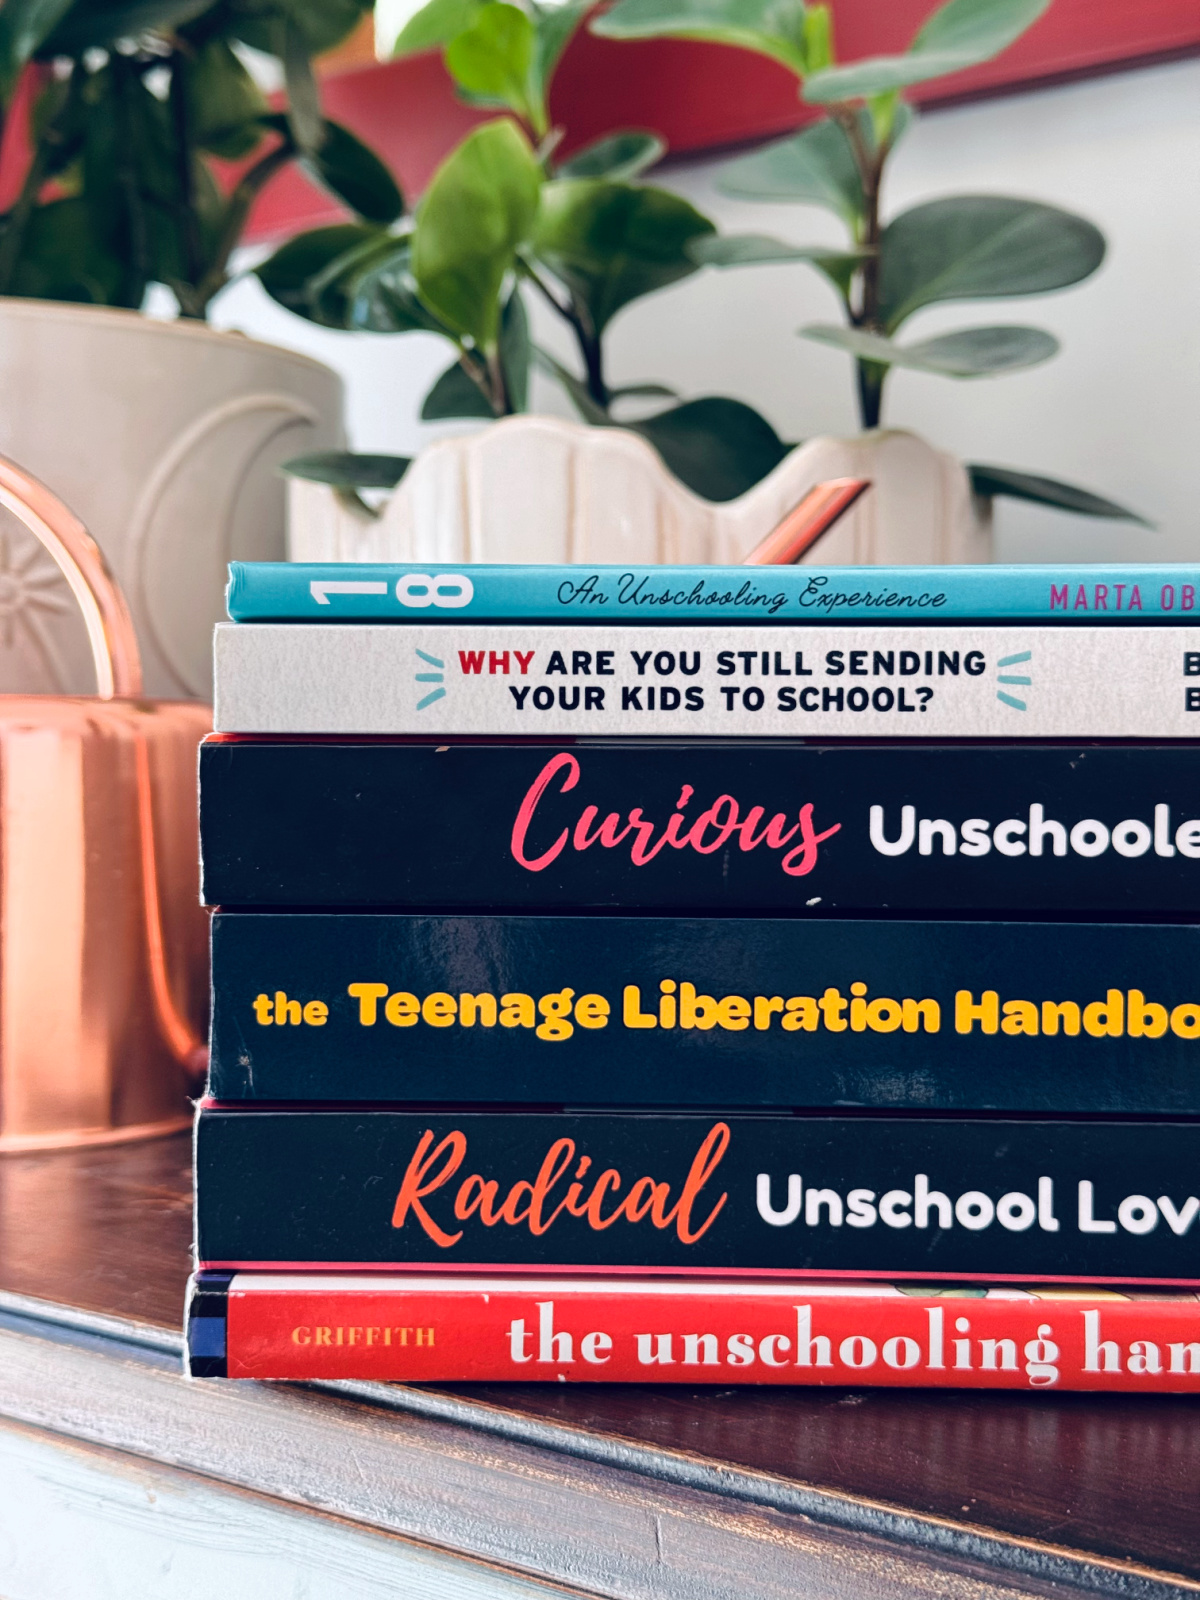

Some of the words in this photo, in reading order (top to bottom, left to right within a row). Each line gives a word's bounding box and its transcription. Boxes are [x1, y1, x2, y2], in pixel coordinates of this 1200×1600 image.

[557, 573, 609, 606] An
[617, 573, 788, 614] Unschooling
[799, 575, 948, 614] Experience
[1049, 583, 1143, 612] MARTA
[458, 650, 536, 675] WHY
[545, 650, 616, 676] ARE
[631, 650, 702, 676] YOU
[716, 650, 813, 677] STILL
[824, 650, 987, 677] SENDING
[508, 685, 606, 711] YOUR
[621, 685, 704, 711] KIDS
[720, 686, 765, 712] TO
[777, 686, 934, 712] SCHOOL?
[510, 752, 842, 877] Curious
[252, 991, 329, 1027] the
[347, 982, 611, 1042] Teenage
[622, 979, 941, 1034] Liberation
[391, 1122, 731, 1248] Radical
[756, 1173, 1060, 1232] Unschool
[291, 1326, 436, 1348] GRIFFITH
[506, 1301, 614, 1364] the
[634, 1304, 1060, 1387] unschooling
